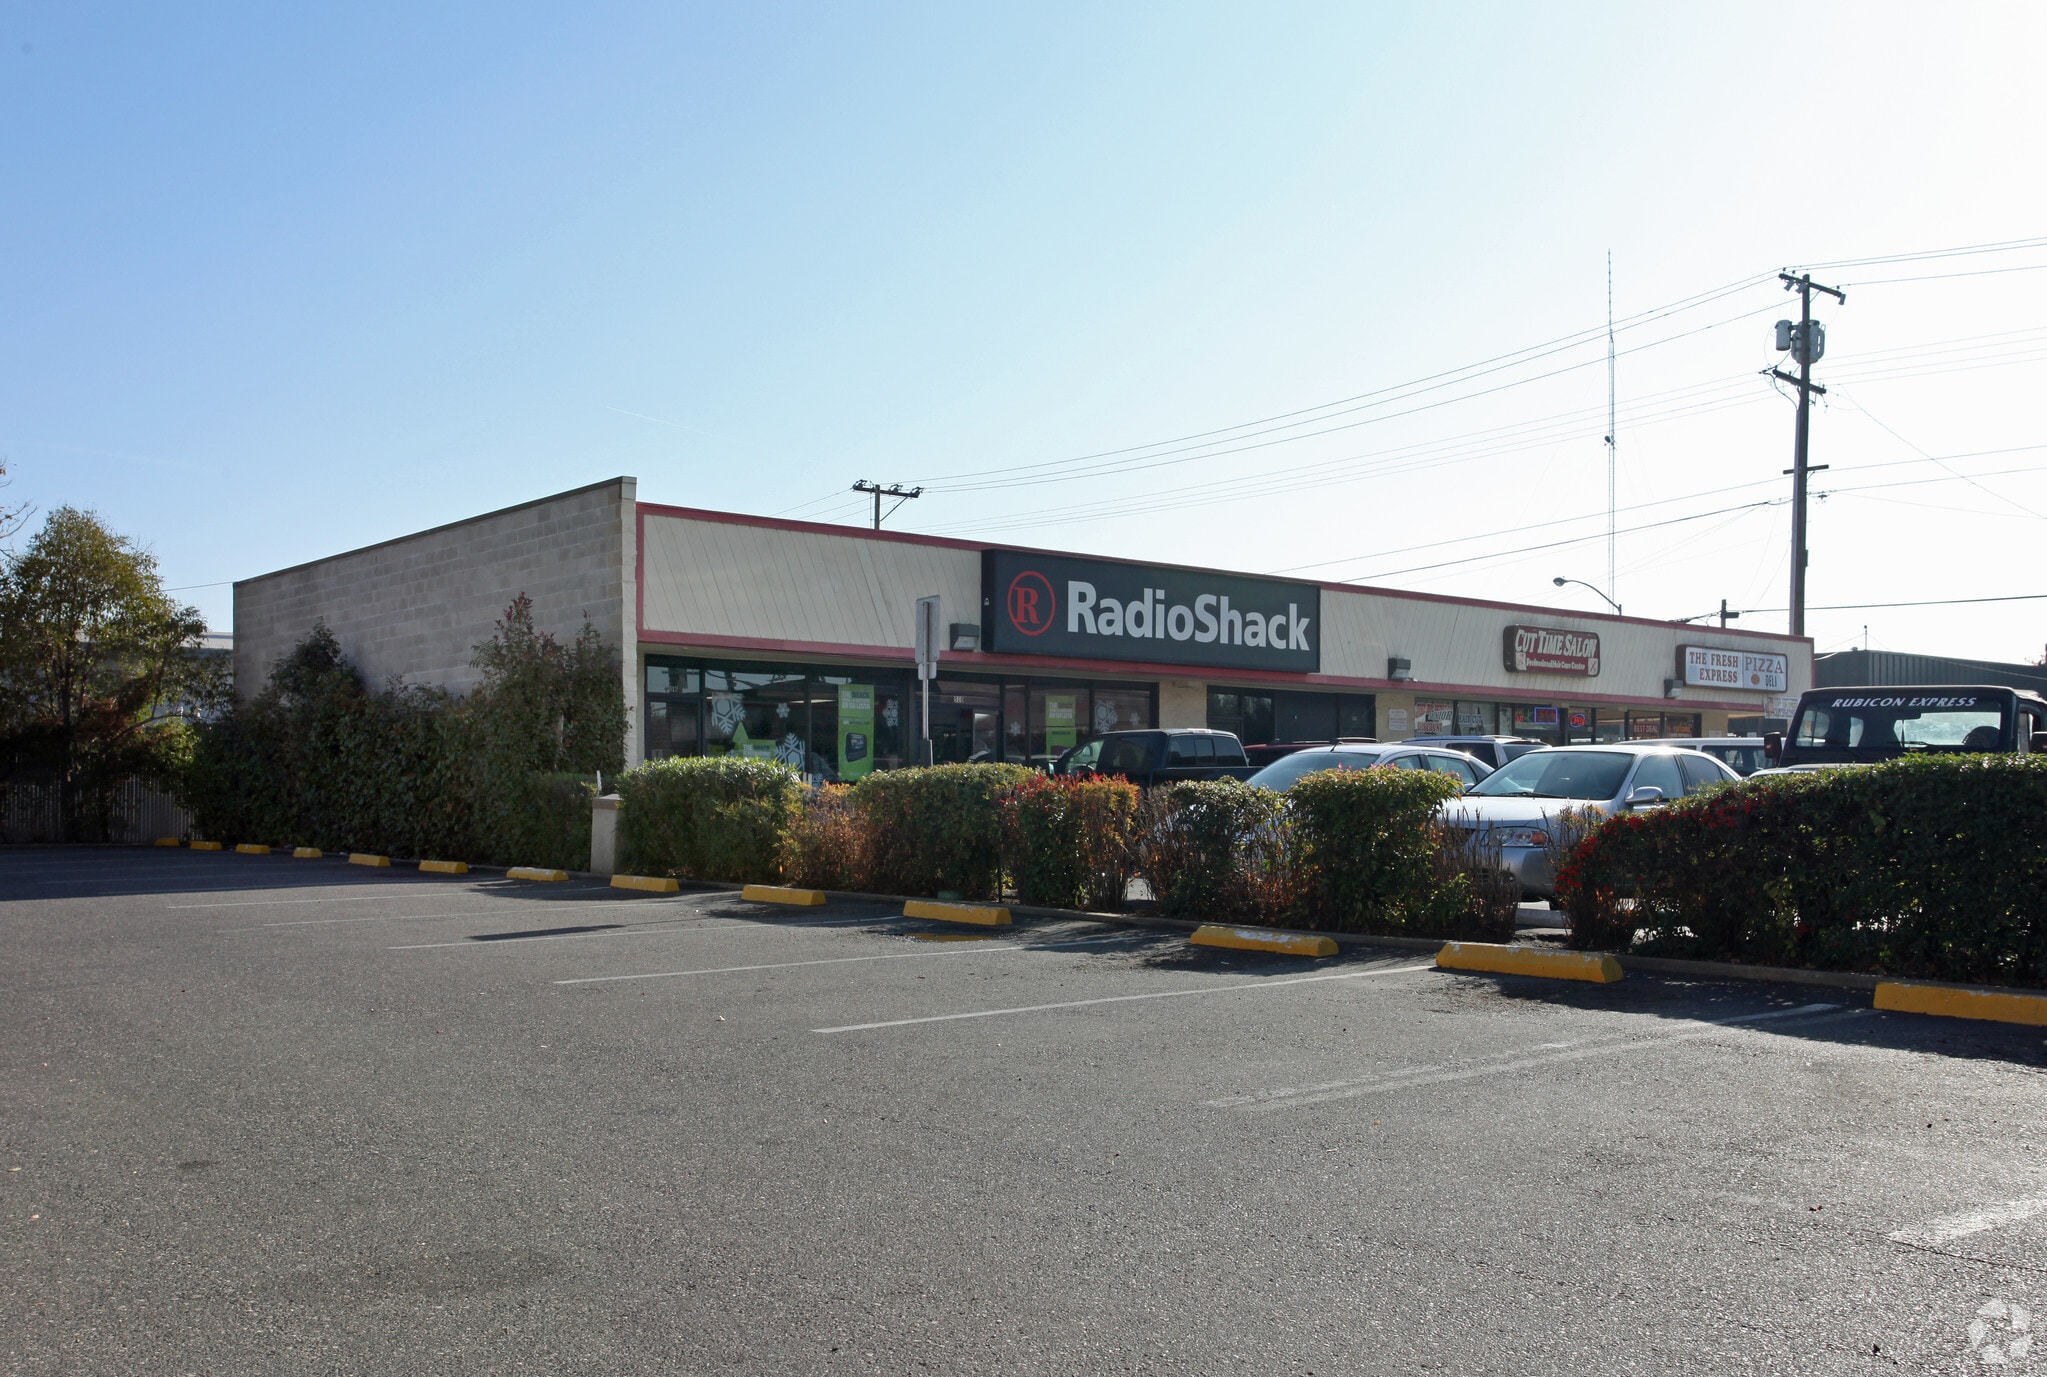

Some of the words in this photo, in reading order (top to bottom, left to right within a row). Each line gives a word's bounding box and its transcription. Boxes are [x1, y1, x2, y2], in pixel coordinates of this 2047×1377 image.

[1067, 580, 1310, 651] RadioShack
[1515, 629, 1537, 653] CUT
[1537, 630, 1563, 655] TIME
[1563, 633, 1597, 658] SALON
[1689, 652, 1707, 665] THE
[1711, 653, 1739, 668] FRESH
[1745, 656, 1784, 674] PIZZA
[1699, 668, 1738, 683] EXPRESS
[1765, 675, 1777, 688] DELI
[1832, 698, 1905, 708] RUBICON
[1908, 697, 1977, 708] EXPRESS
[1633, 724, 1645, 733] BEST
